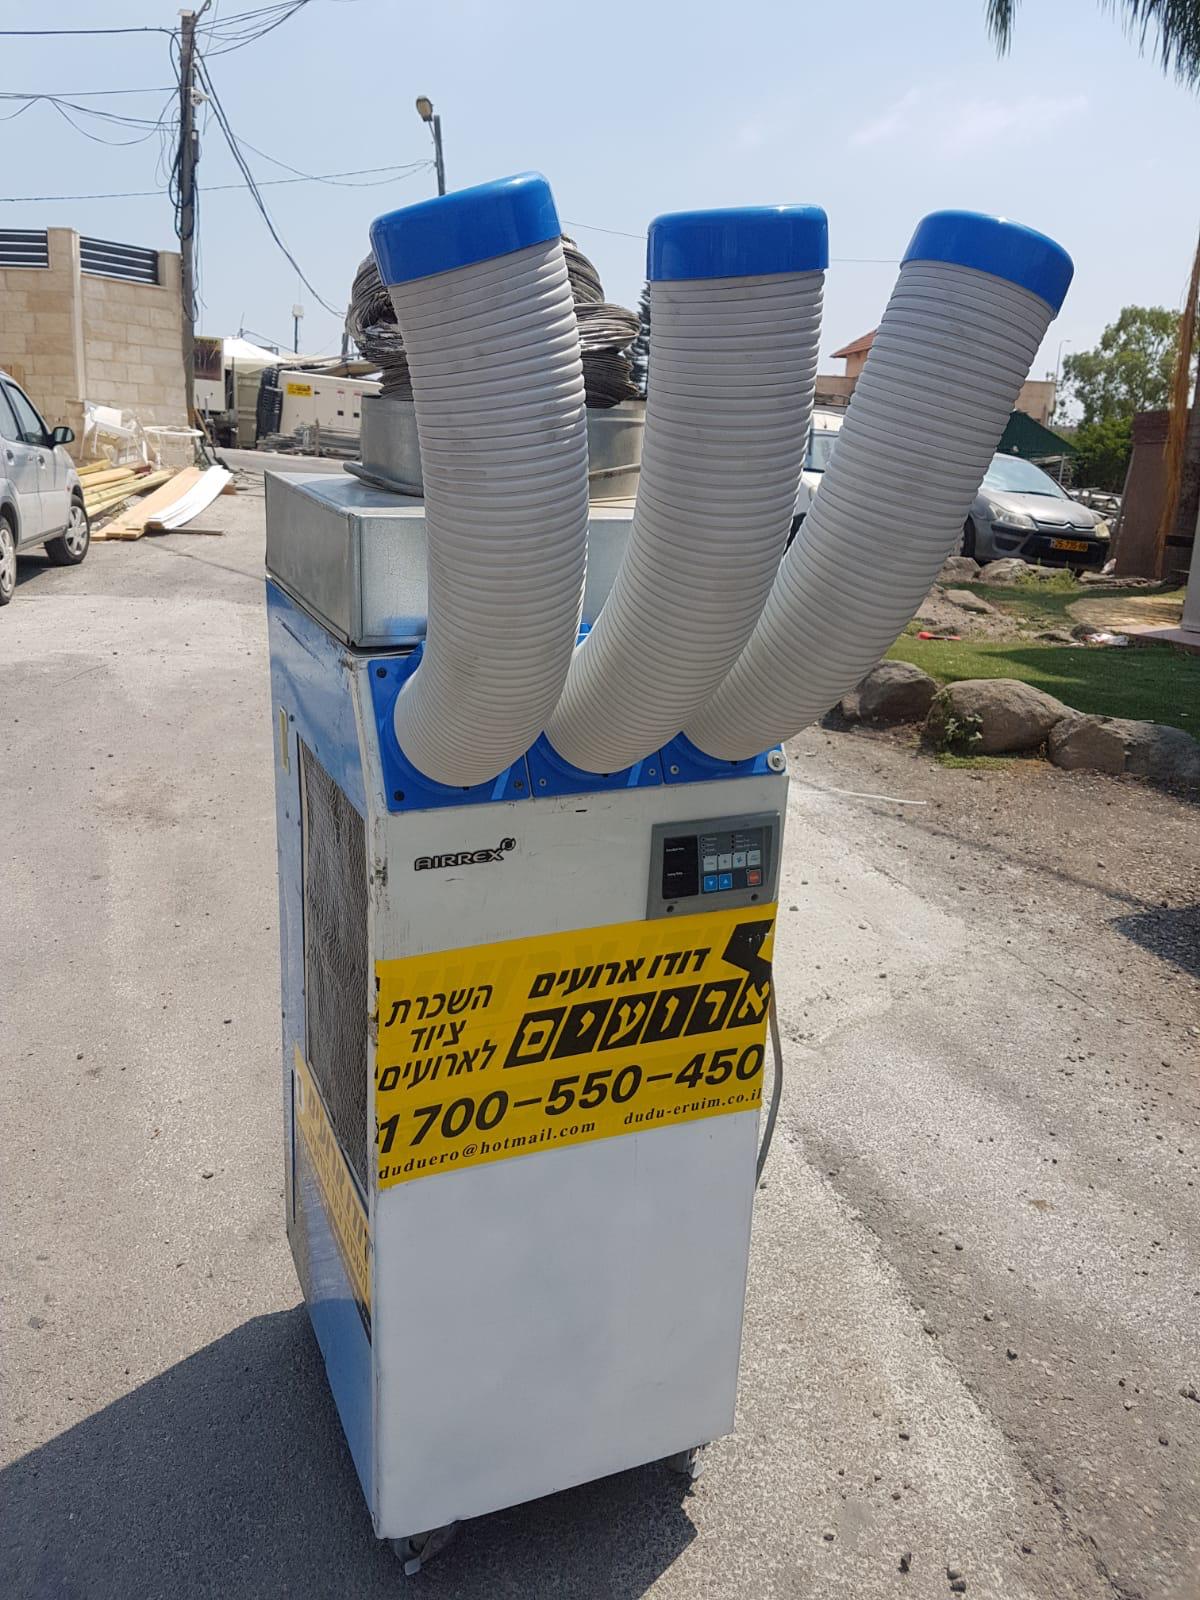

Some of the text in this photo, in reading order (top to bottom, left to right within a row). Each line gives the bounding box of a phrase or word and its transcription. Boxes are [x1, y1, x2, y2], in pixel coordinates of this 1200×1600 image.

[414, 845, 505, 871] AIRREX
[527, 947, 712, 999] דודו ארועים
[384, 984, 494, 1027] השכרת
[503, 979, 770, 1067] ארועים
[410, 1019, 467, 1053] ציוד
[377, 1039, 498, 1092] לארועים
[623, 1087, 762, 1125] dudu-eruim.co.il
[378, 1120, 596, 1180] duduero@hotmail.com
